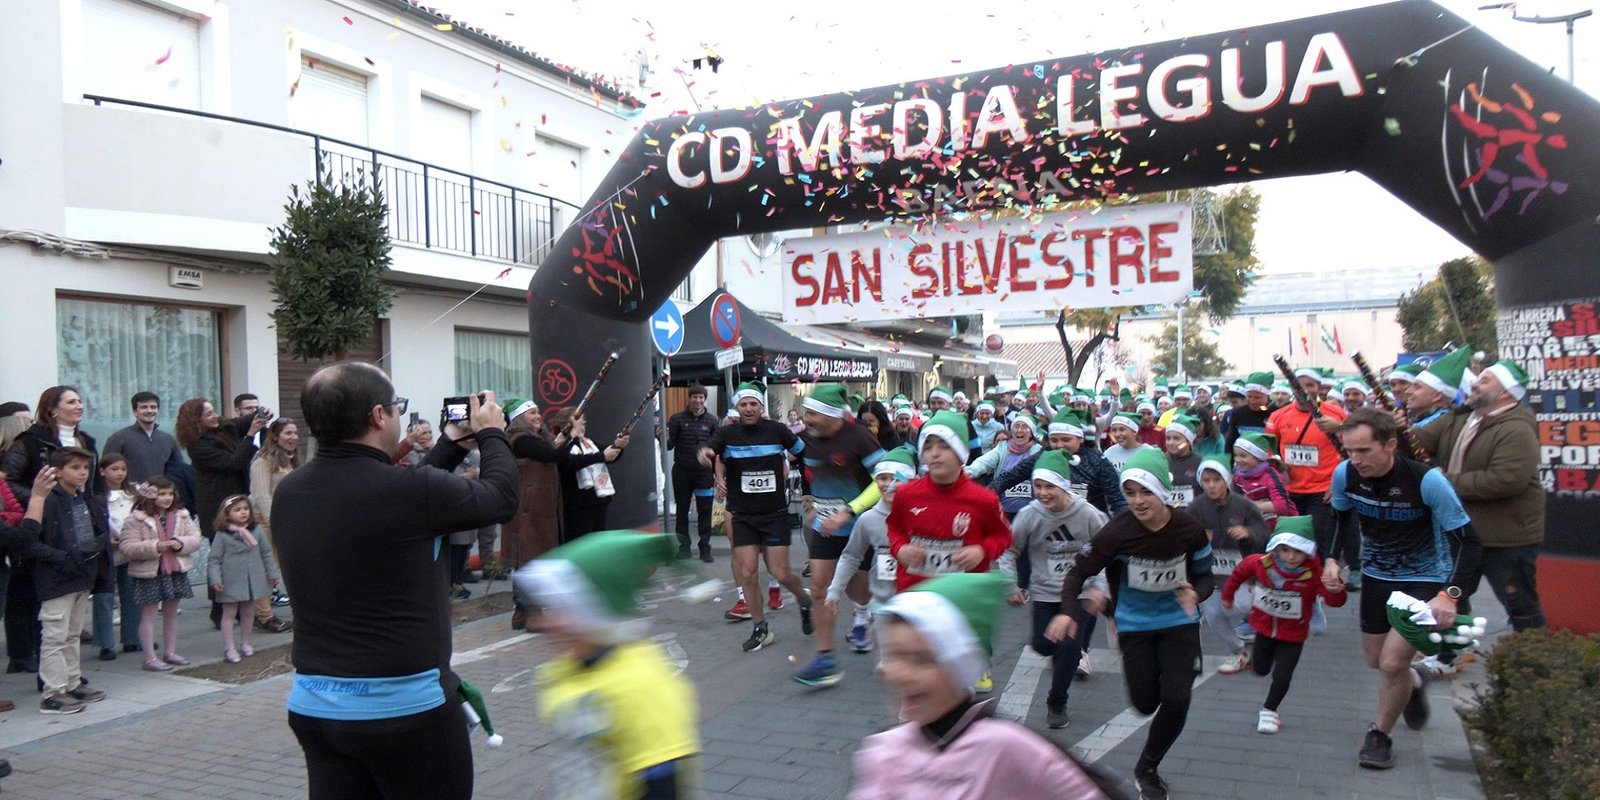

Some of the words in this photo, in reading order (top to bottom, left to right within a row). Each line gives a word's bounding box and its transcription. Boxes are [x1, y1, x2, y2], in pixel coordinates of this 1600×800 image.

[666, 126, 754, 190] CD
[776, 83, 1029, 178] MEDIA
[1055, 32, 1365, 139] LEGUA
[791, 247, 883, 308] SAN
[908, 221, 1181, 299] SILVESTRE
[797, 356, 808, 375] CD
[808, 357, 829, 377] MEDIA
[829, 359, 851, 377] LEGUA
[1290, 451, 1312, 460] 316
[748, 478, 770, 488] 401
[1010, 485, 1029, 493] 242
[1139, 569, 1176, 583] 170
